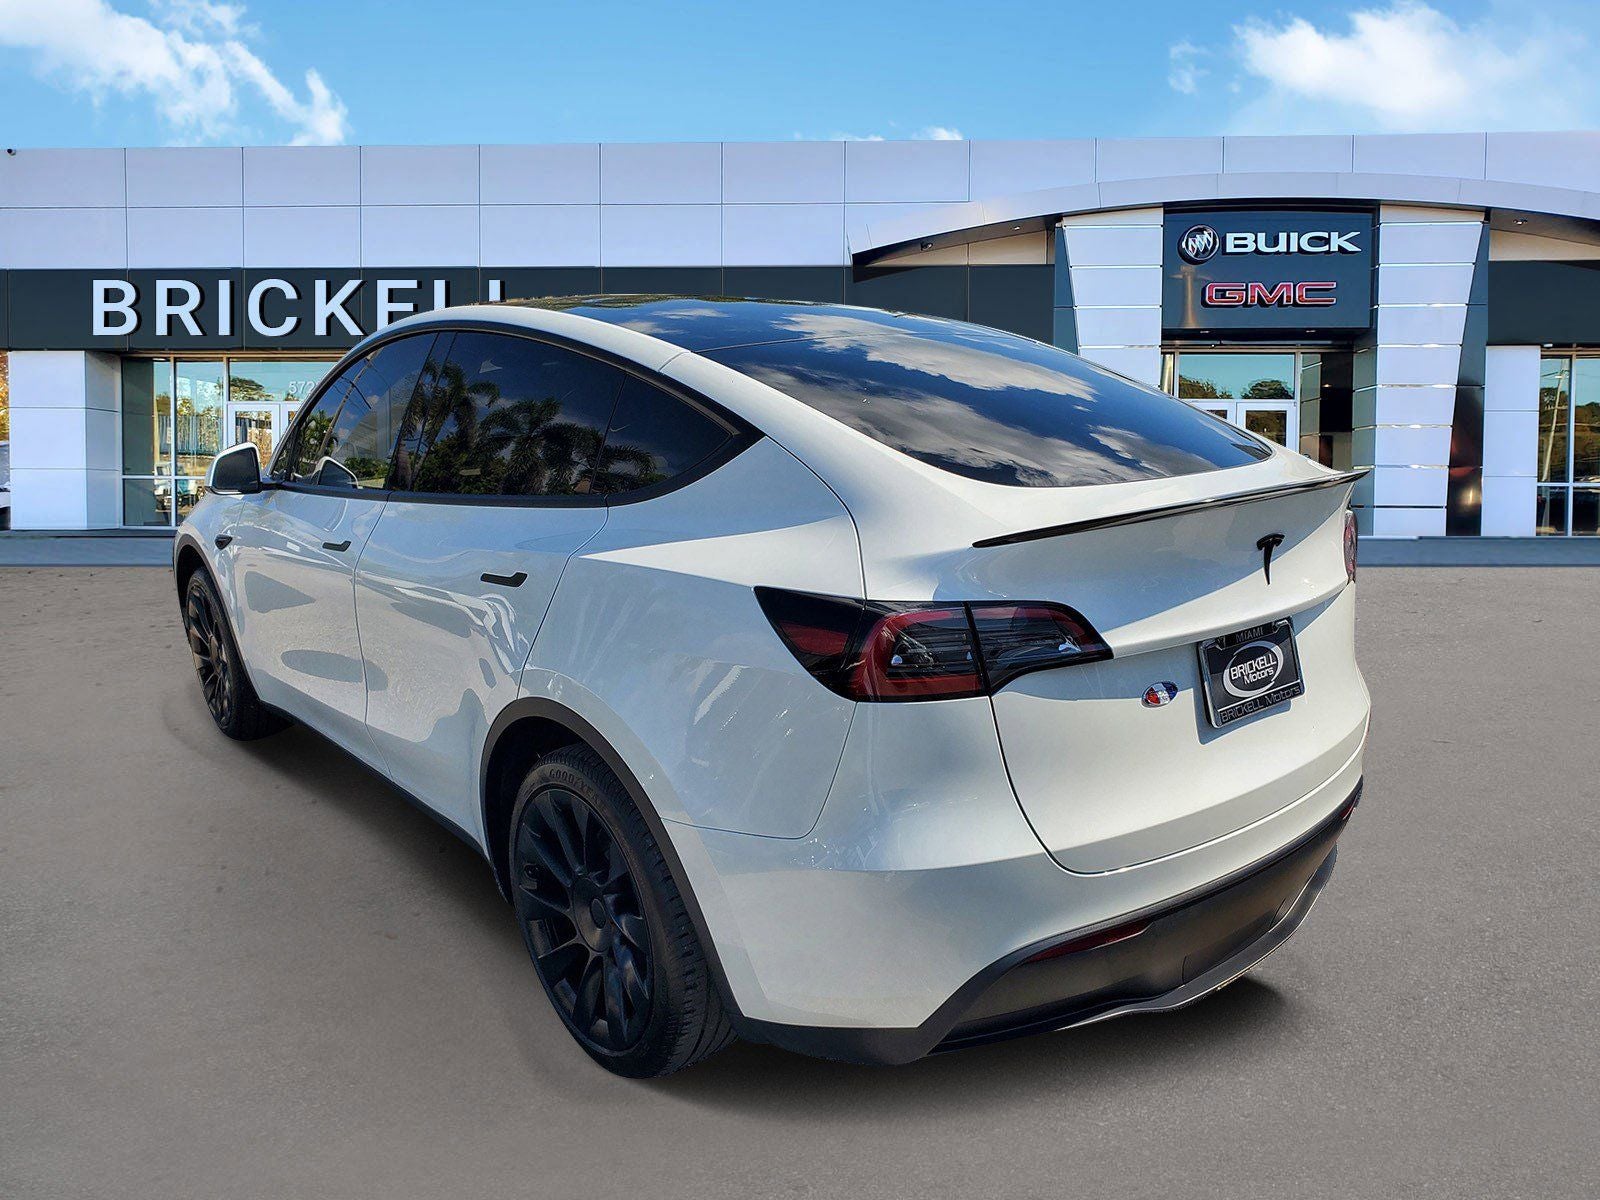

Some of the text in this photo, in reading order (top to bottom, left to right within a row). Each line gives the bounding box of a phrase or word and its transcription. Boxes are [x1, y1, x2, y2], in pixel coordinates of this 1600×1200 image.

[1225, 231, 1362, 253] BUICK
[1205, 281, 1337, 305] GMC
[92, 279, 501, 336] BRICKE
[288, 381, 320, 394] 572
[1236, 627, 1264, 642] MIAMI
[1230, 654, 1277, 680] BRICKELL
[1243, 667, 1275, 685] Motors
[1220, 686, 1301, 722] BRICKELL Motors
